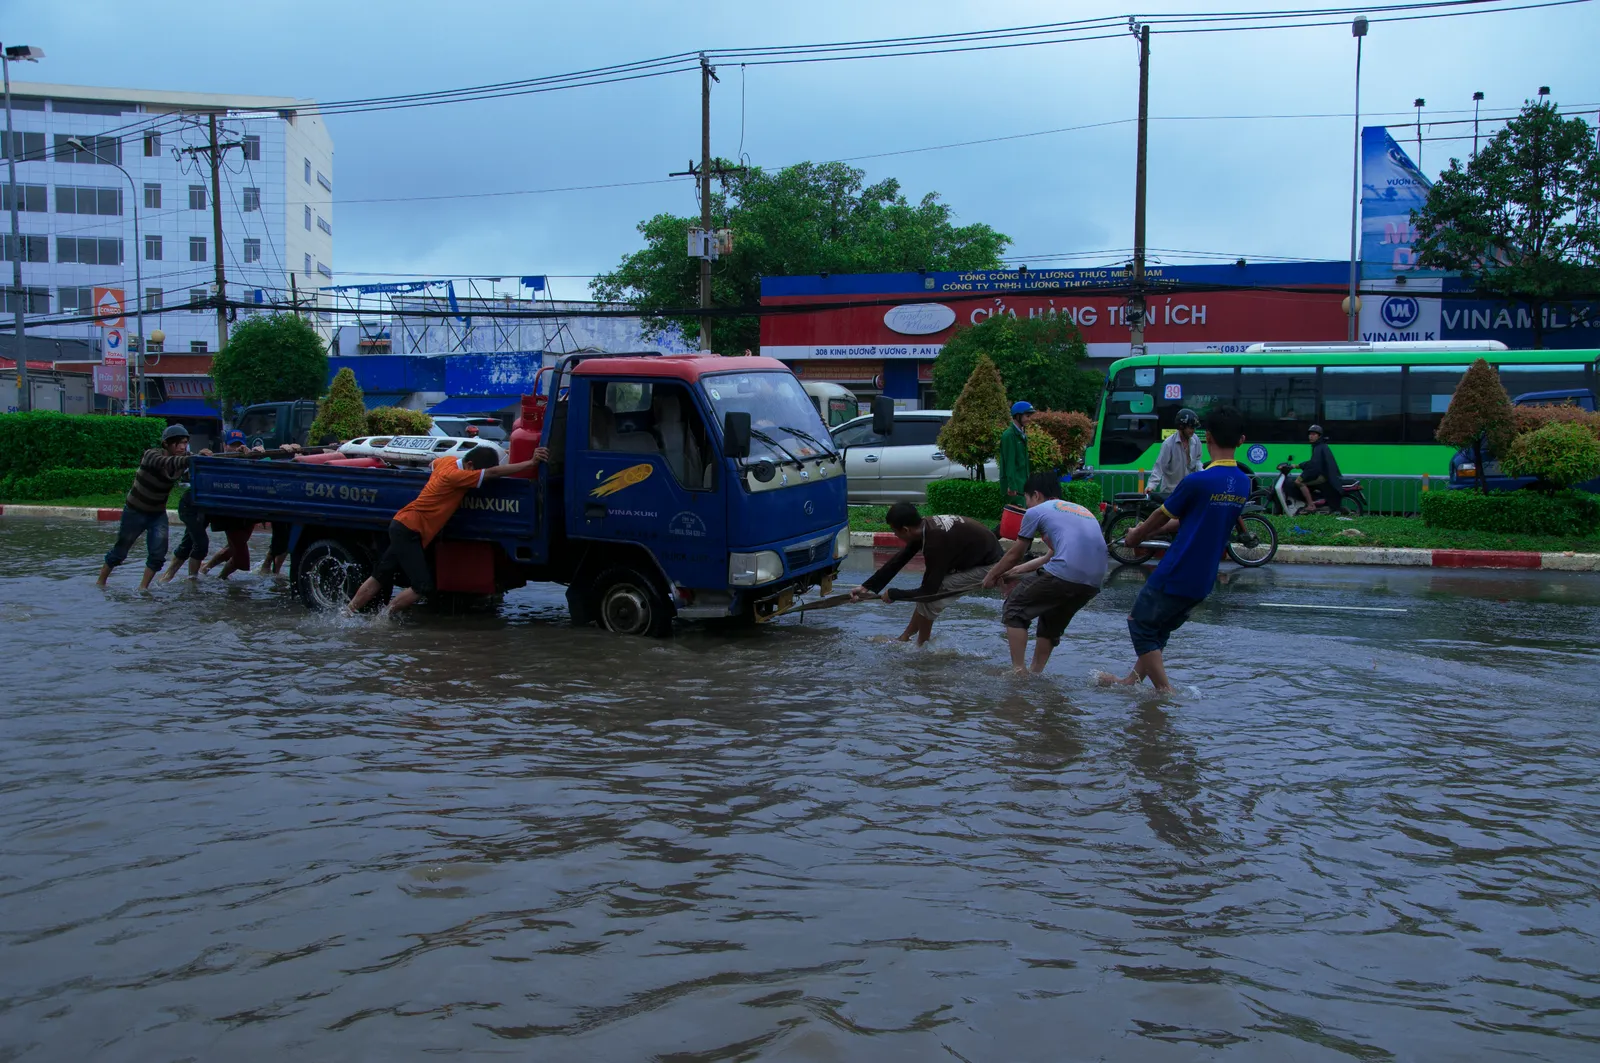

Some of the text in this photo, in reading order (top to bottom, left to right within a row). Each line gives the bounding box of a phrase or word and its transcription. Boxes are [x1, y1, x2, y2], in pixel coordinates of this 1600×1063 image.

[958, 271, 985, 282] TỔNG
[989, 271, 1018, 281] CÔNG
[1040, 271, 1074, 280] LƯƠNG
[942, 281, 972, 291] CÔNG
[1025, 281, 1059, 289] LƯƠNG
[1164, 298, 1206, 325] ÍCH
[1442, 307, 1591, 329] VINAMILK
[1363, 332, 1435, 342] VINAMILK
[830, 348, 847, 356] KINH
[103, 384, 122, 393] 24/24
[1166, 385, 1180, 398] 39
[305, 482, 379, 504] 54X 9017
[460, 496, 520, 513] INAXUKI
[608, 508, 658, 518] VINAXUKI
